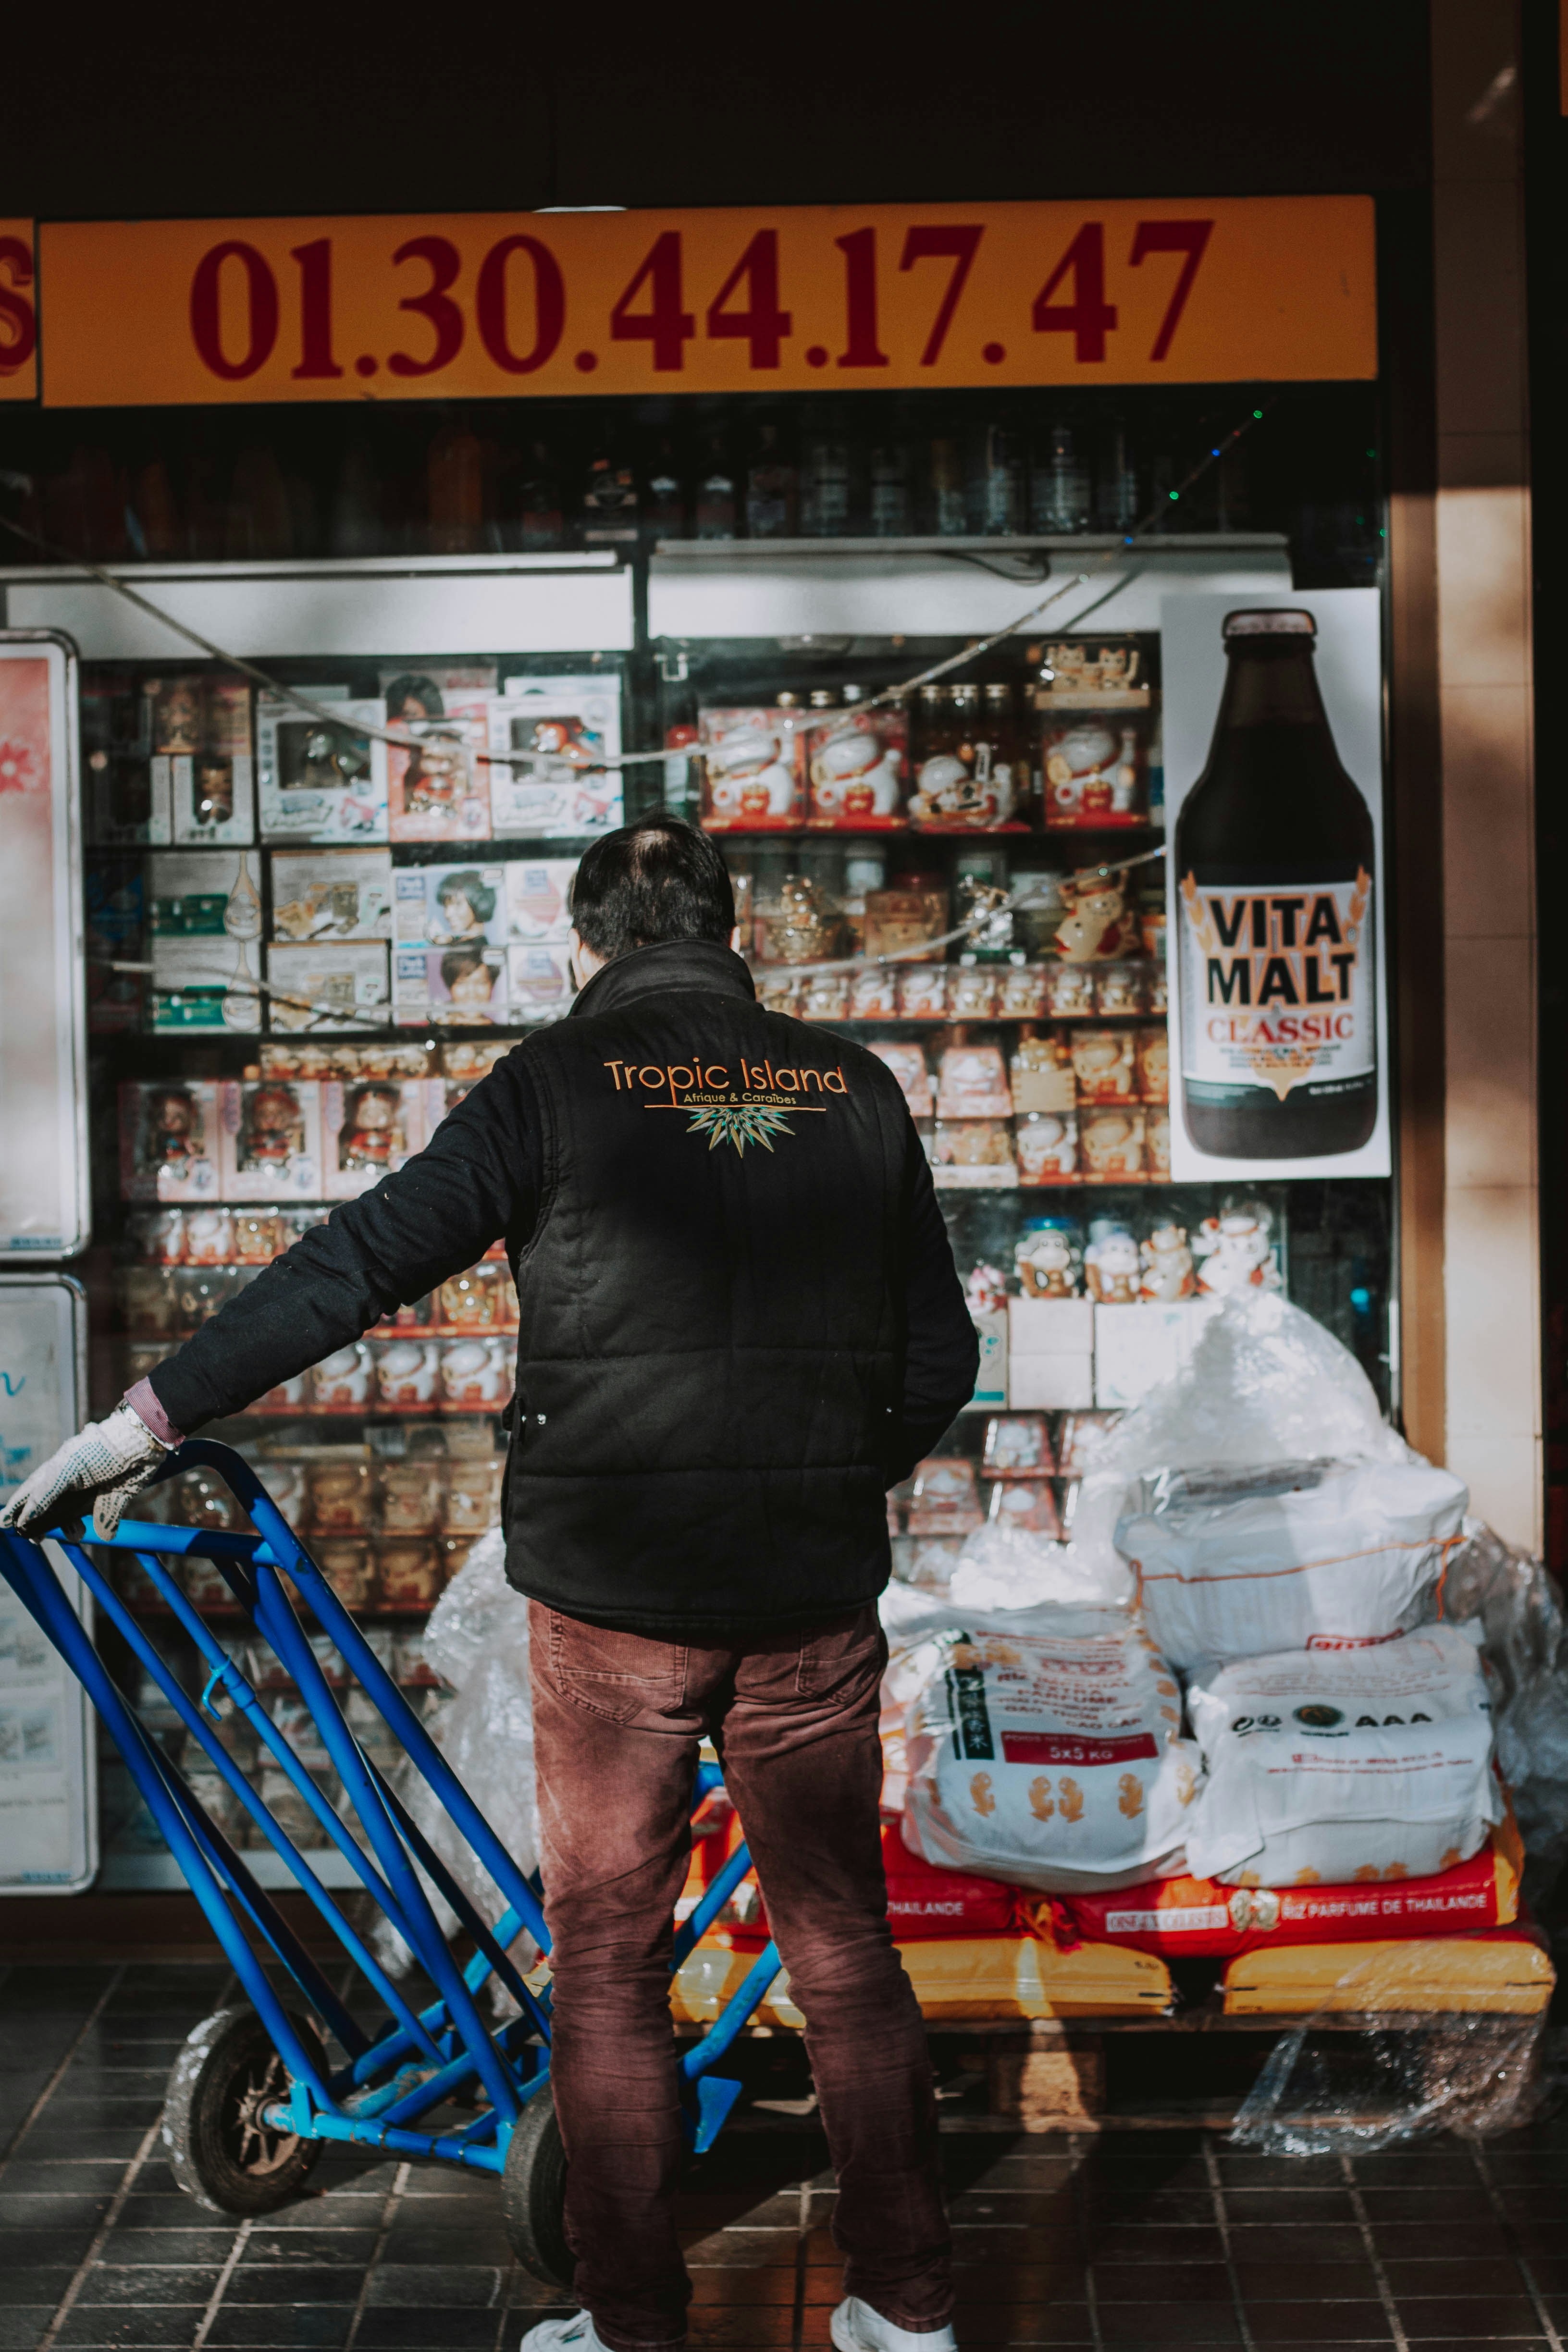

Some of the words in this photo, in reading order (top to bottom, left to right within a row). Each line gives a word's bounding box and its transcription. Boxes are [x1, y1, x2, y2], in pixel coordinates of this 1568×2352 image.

[190, 220, 1216, 382] 01.30.44.17.47
[1209, 897, 1342, 948] VITA
[1207, 953, 1355, 1006] MALT
[1207, 1013, 1354, 1044] CLASSIC
[604, 1057, 730, 1106] Tropic
[741, 1058, 848, 1094] Island
[683, 1092, 726, 1104] Afrique
[730, 1093, 738, 1102] &
[1382, 1898, 1402, 1914] DE
[1406, 1893, 1488, 1911] THAILANDE
